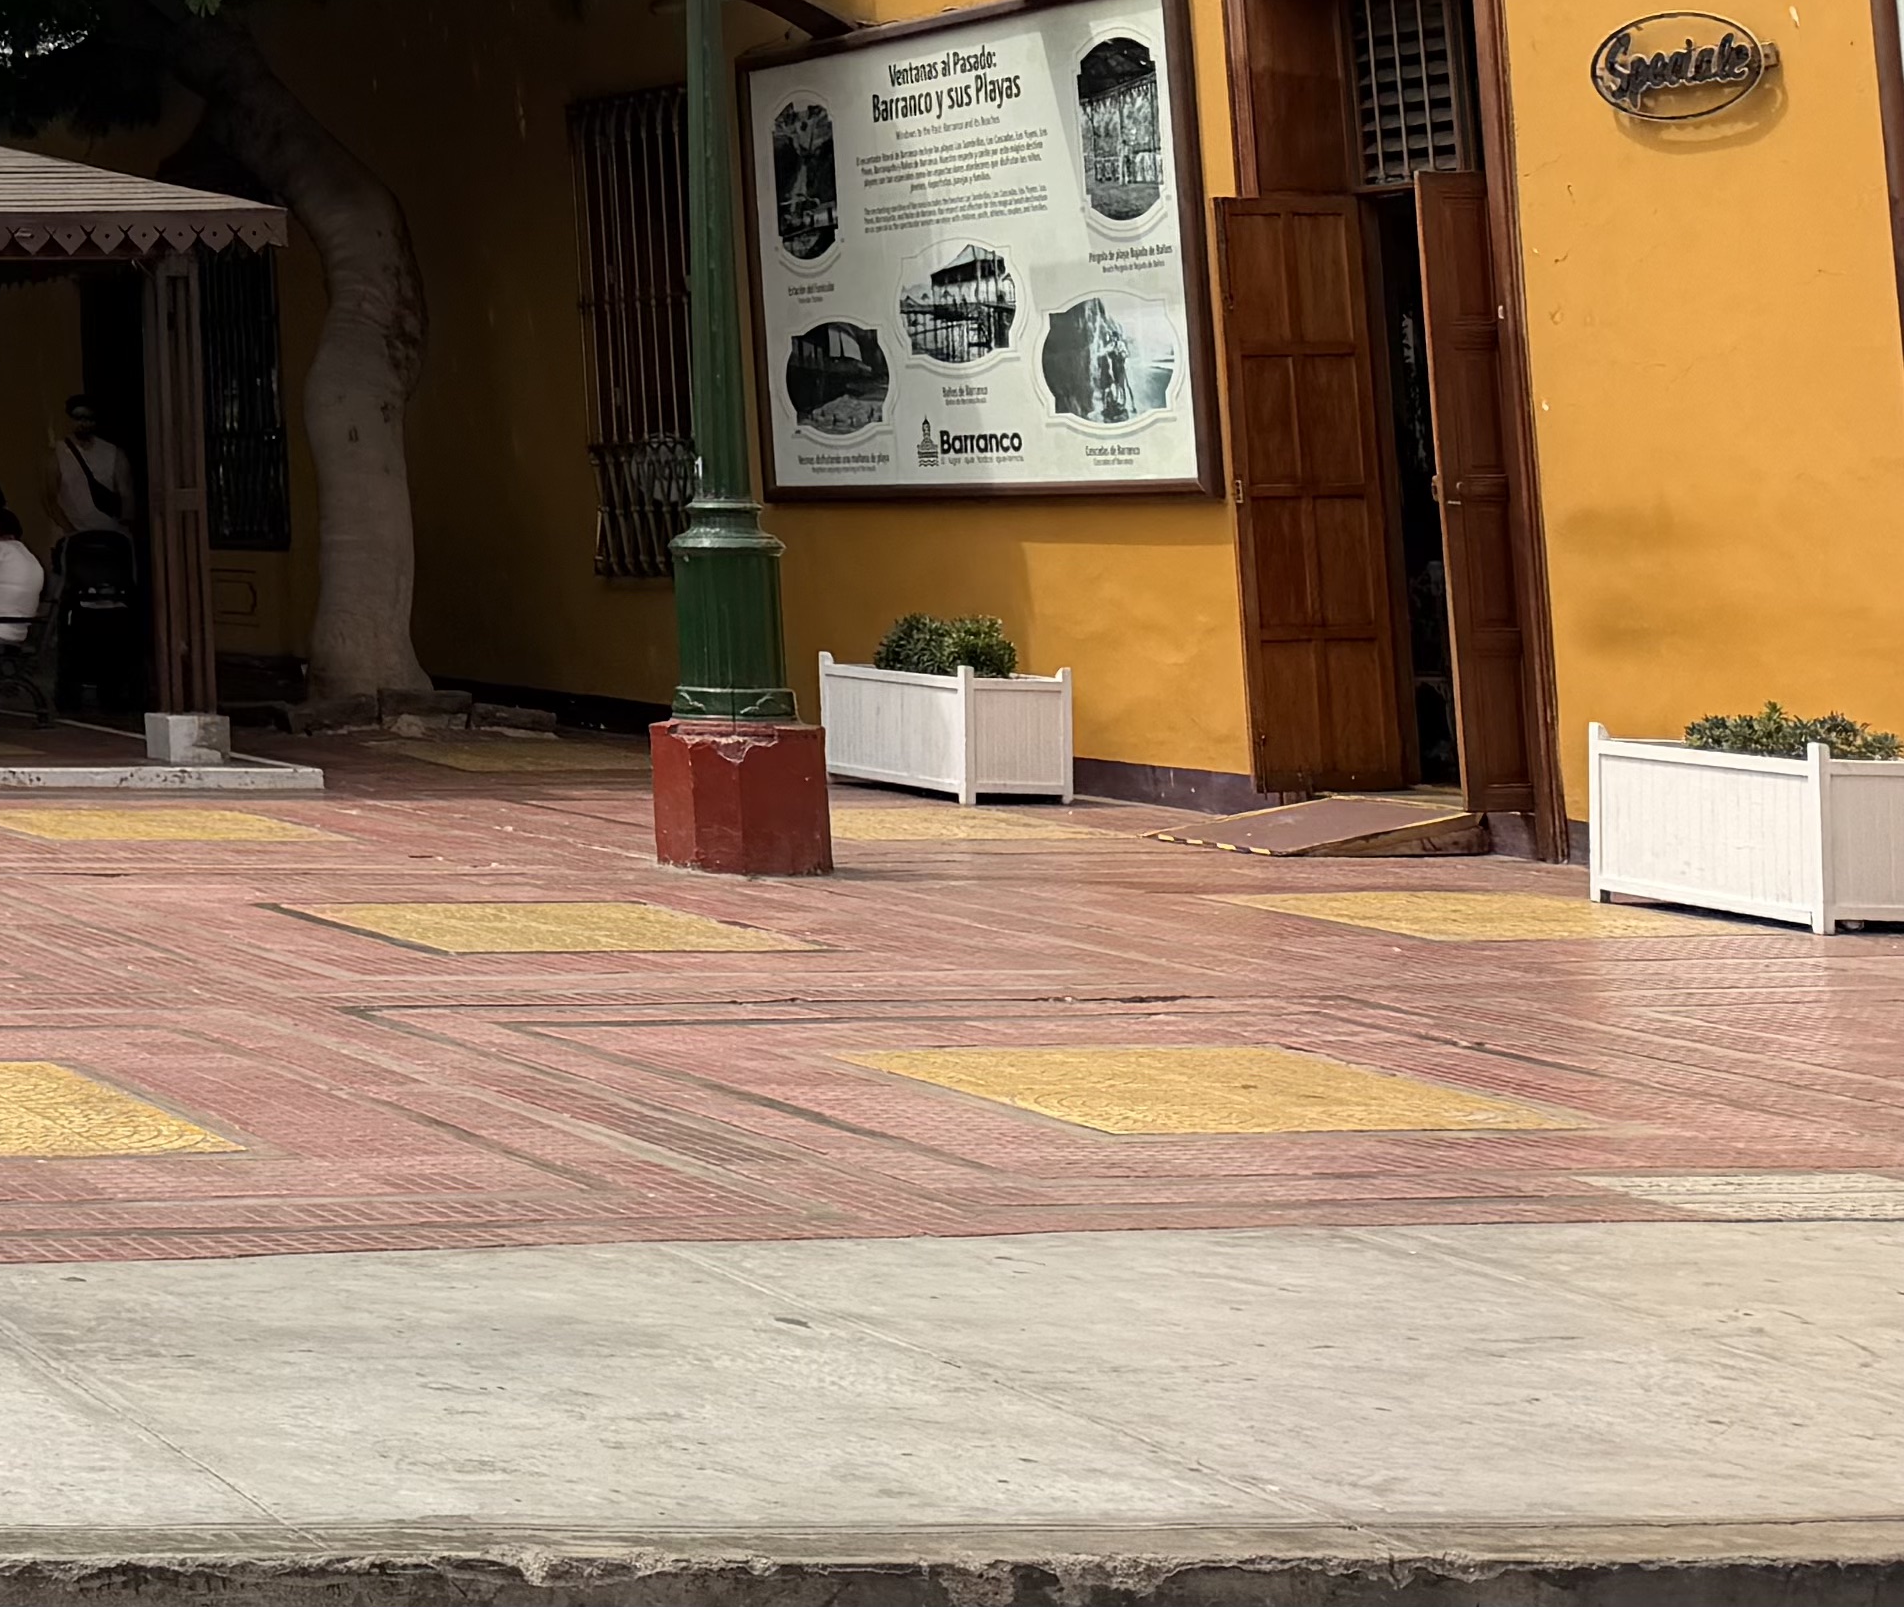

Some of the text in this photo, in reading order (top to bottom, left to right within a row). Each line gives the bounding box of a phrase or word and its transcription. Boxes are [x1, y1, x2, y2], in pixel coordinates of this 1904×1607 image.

[888, 44, 998, 88] Ventanas al Pasado:
[1604, 32, 1753, 111] Speciale
[872, 72, 1021, 123] Barranco y sus Playas
[940, 430, 1023, 454] Barranco
